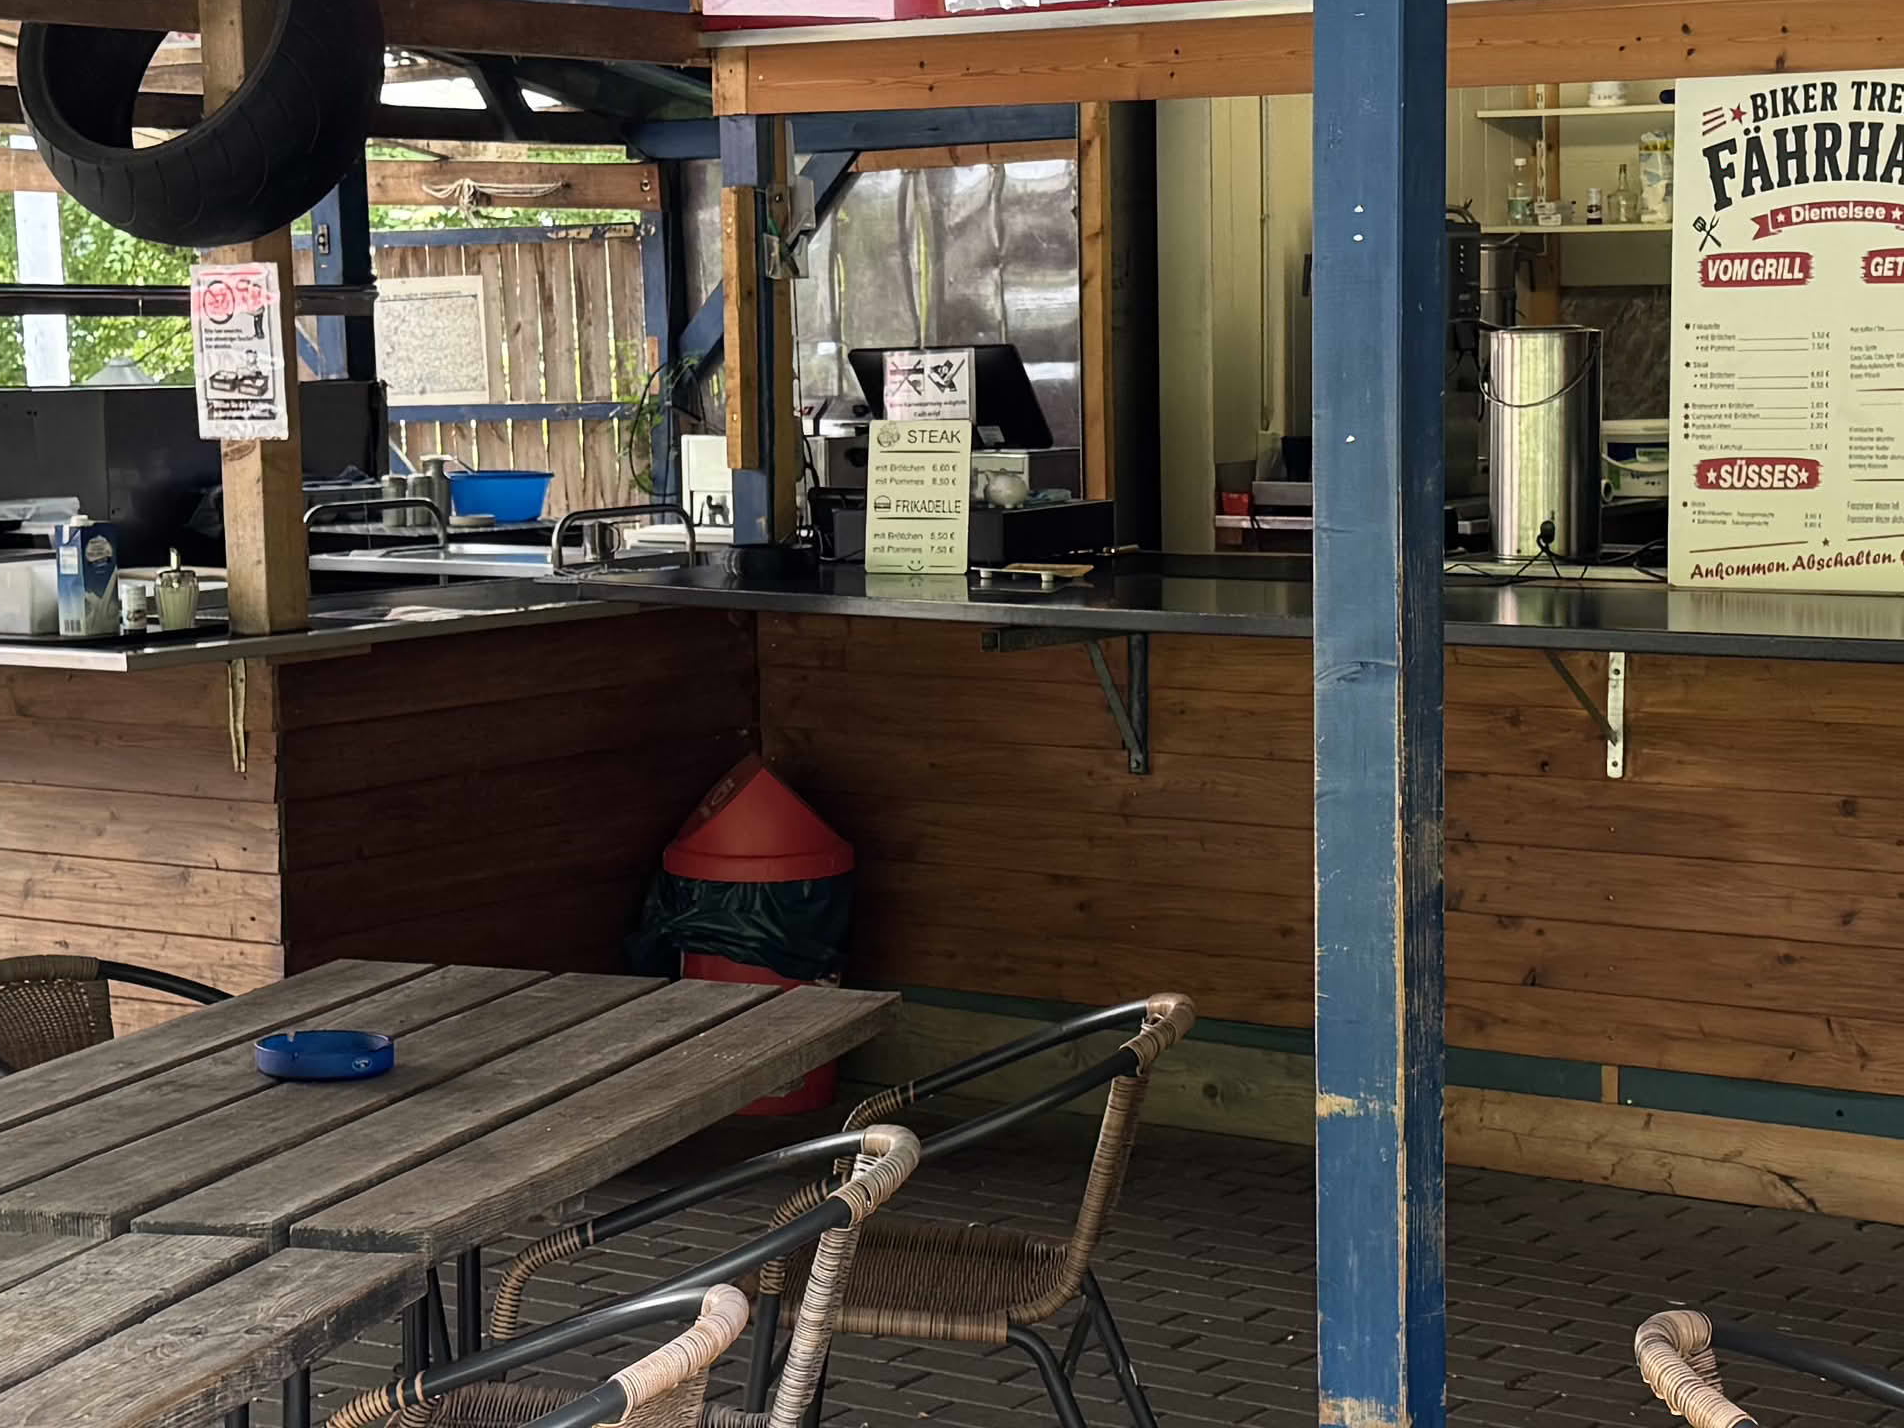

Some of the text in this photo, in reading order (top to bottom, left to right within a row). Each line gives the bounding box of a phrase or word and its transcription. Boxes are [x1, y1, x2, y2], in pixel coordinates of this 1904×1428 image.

[1750, 81, 1838, 123] BIKER
[1791, 202, 1886, 223] Diemelsee
[1707, 256, 1804, 282] VOM GRILL
[907, 429, 961, 445] STEAK
[1719, 459, 1801, 489] SÜSSES
[895, 500, 962, 514] FRIKADELLE
